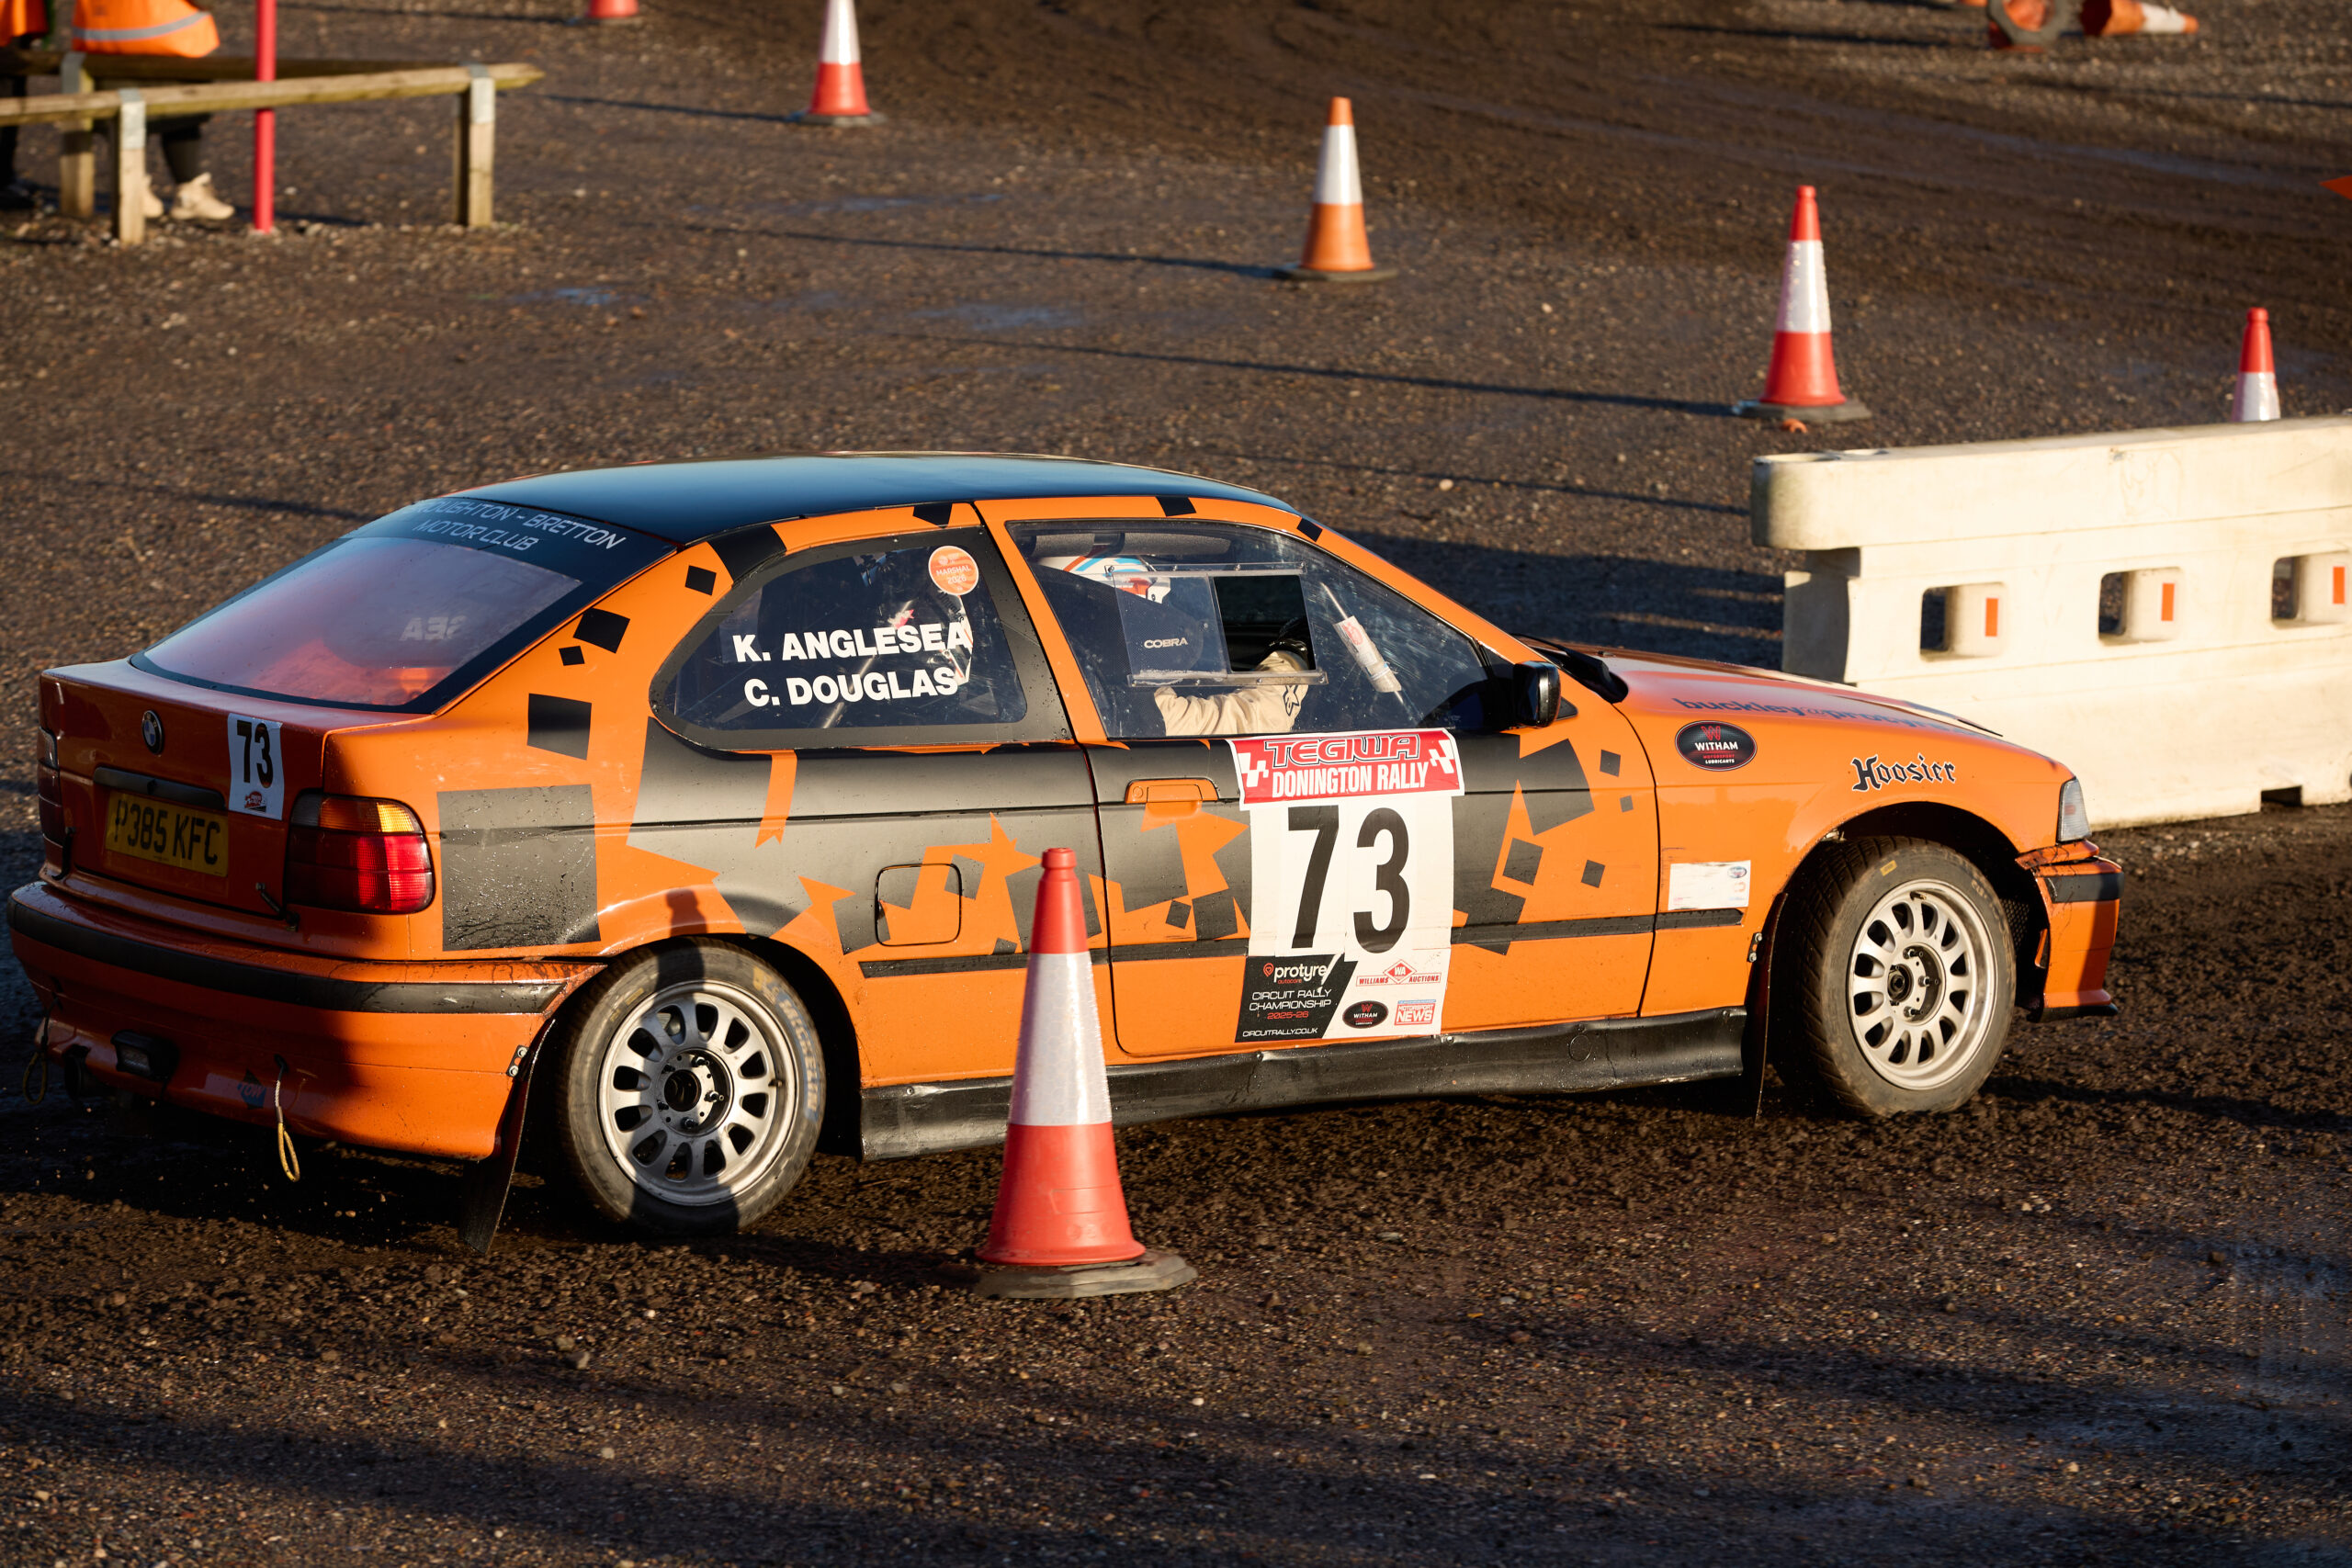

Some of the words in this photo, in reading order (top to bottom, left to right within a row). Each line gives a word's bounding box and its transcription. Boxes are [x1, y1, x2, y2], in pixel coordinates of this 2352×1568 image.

[412, 519, 489, 539] MOTOR
[479, 530, 539, 551] CLUB
[522, 513, 627, 549] BRETTON
[935, 564, 972, 577] MARSHAL
[732, 634, 771, 663] K.
[782, 621, 972, 660] ANGLESEA
[1144, 637, 1189, 649] COBRA
[744, 678, 780, 707] C.
[786, 667, 959, 705] DOUGLAS
[236, 719, 274, 788] 73
[1264, 734, 1420, 768] TEGIWA
[1694, 741, 1739, 751] WITHAM
[1272, 763, 1373, 798] DONINGTON
[1377, 761, 1430, 791] RALLY
[1850, 752, 1956, 792] Hoosier
[114, 799, 167, 853] P385
[173, 813, 220, 865] KFC
[1287, 805, 1410, 953] 73
[1273, 964, 1328, 983] protyre
[1394, 966, 1407, 976] WA
[1250, 999, 1331, 1010] CHAMPIONSHIP
[1252, 990, 1295, 1000] CIRCUIT
[1297, 989, 1331, 998] RALLY
[1267, 1011, 1309, 1020] 2025-26
[1396, 1010, 1433, 1022] NEWS
[1242, 1028, 1317, 1037] CIRCUITRALLY.CO.UK
